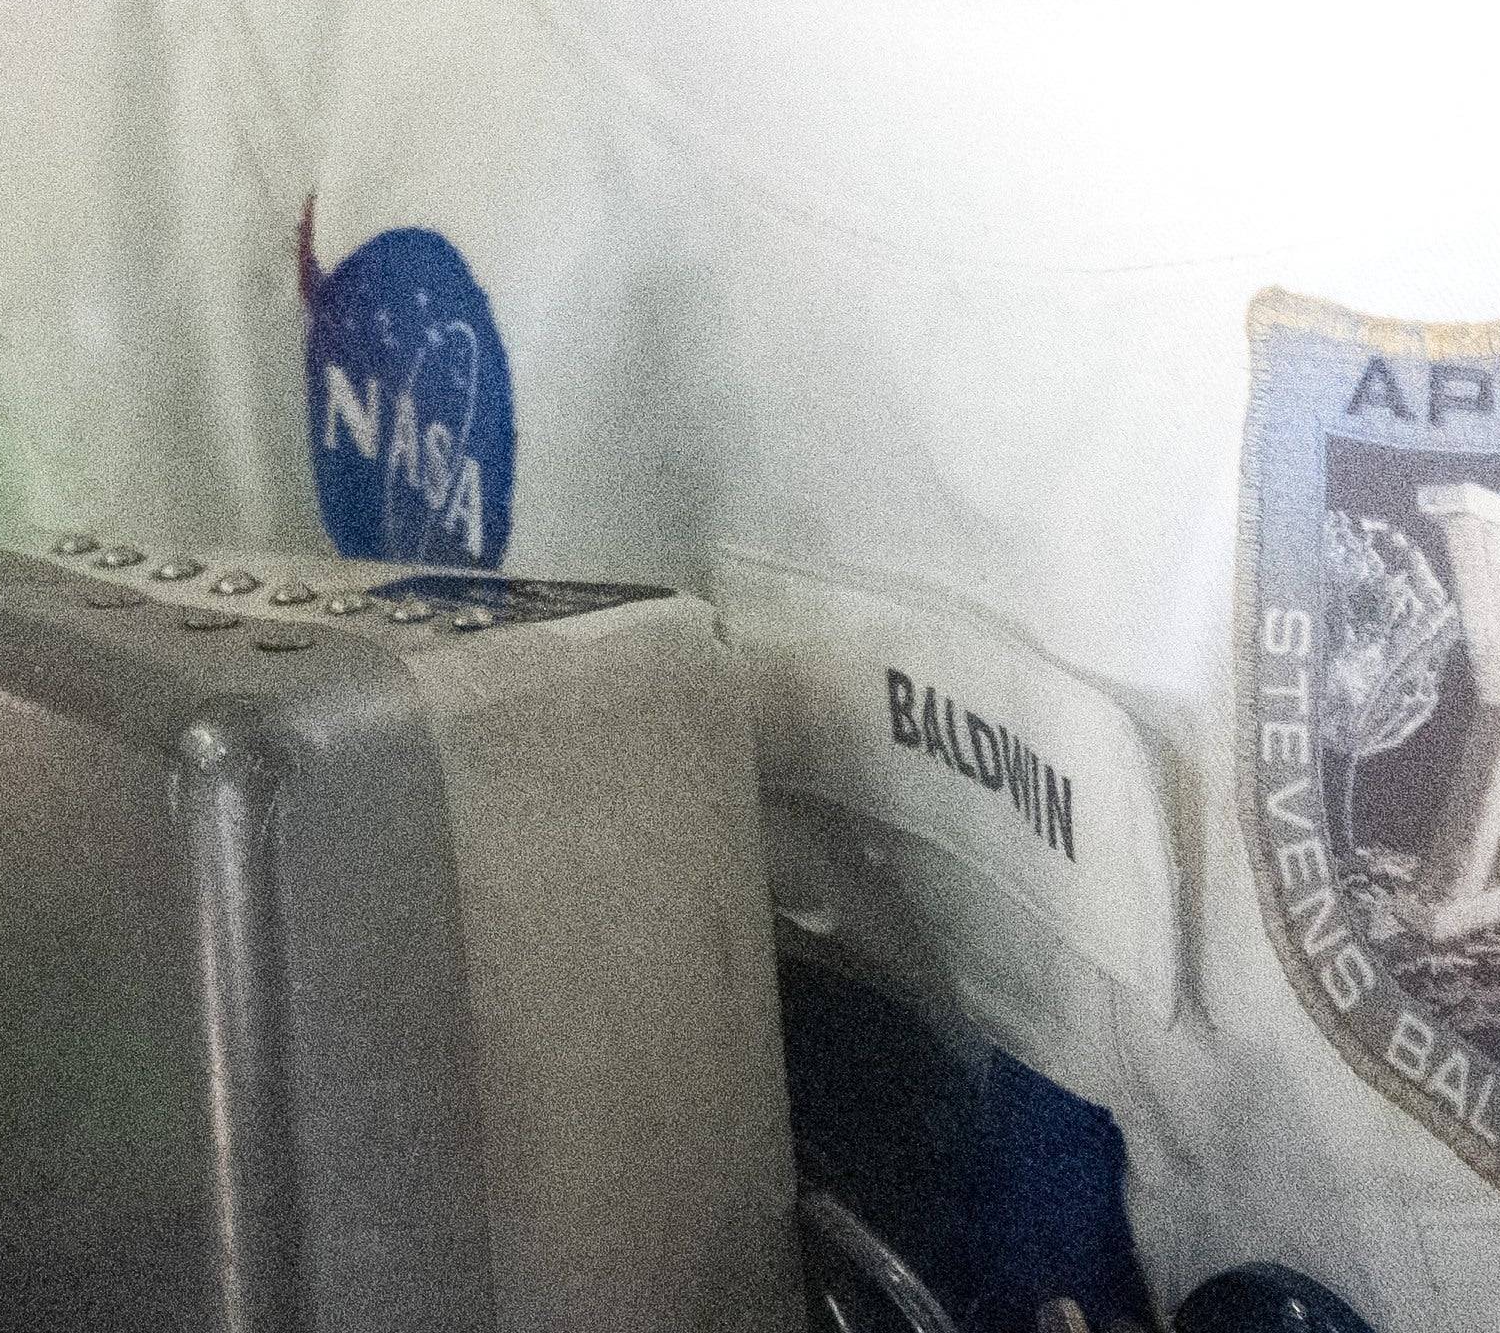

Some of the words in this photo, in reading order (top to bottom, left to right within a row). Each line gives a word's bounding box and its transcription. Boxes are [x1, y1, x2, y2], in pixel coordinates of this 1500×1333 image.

[324, 363, 482, 556] NASA
[886, 668, 1076, 862] BALDWIN
[1263, 608, 1373, 1012] STEVENS
